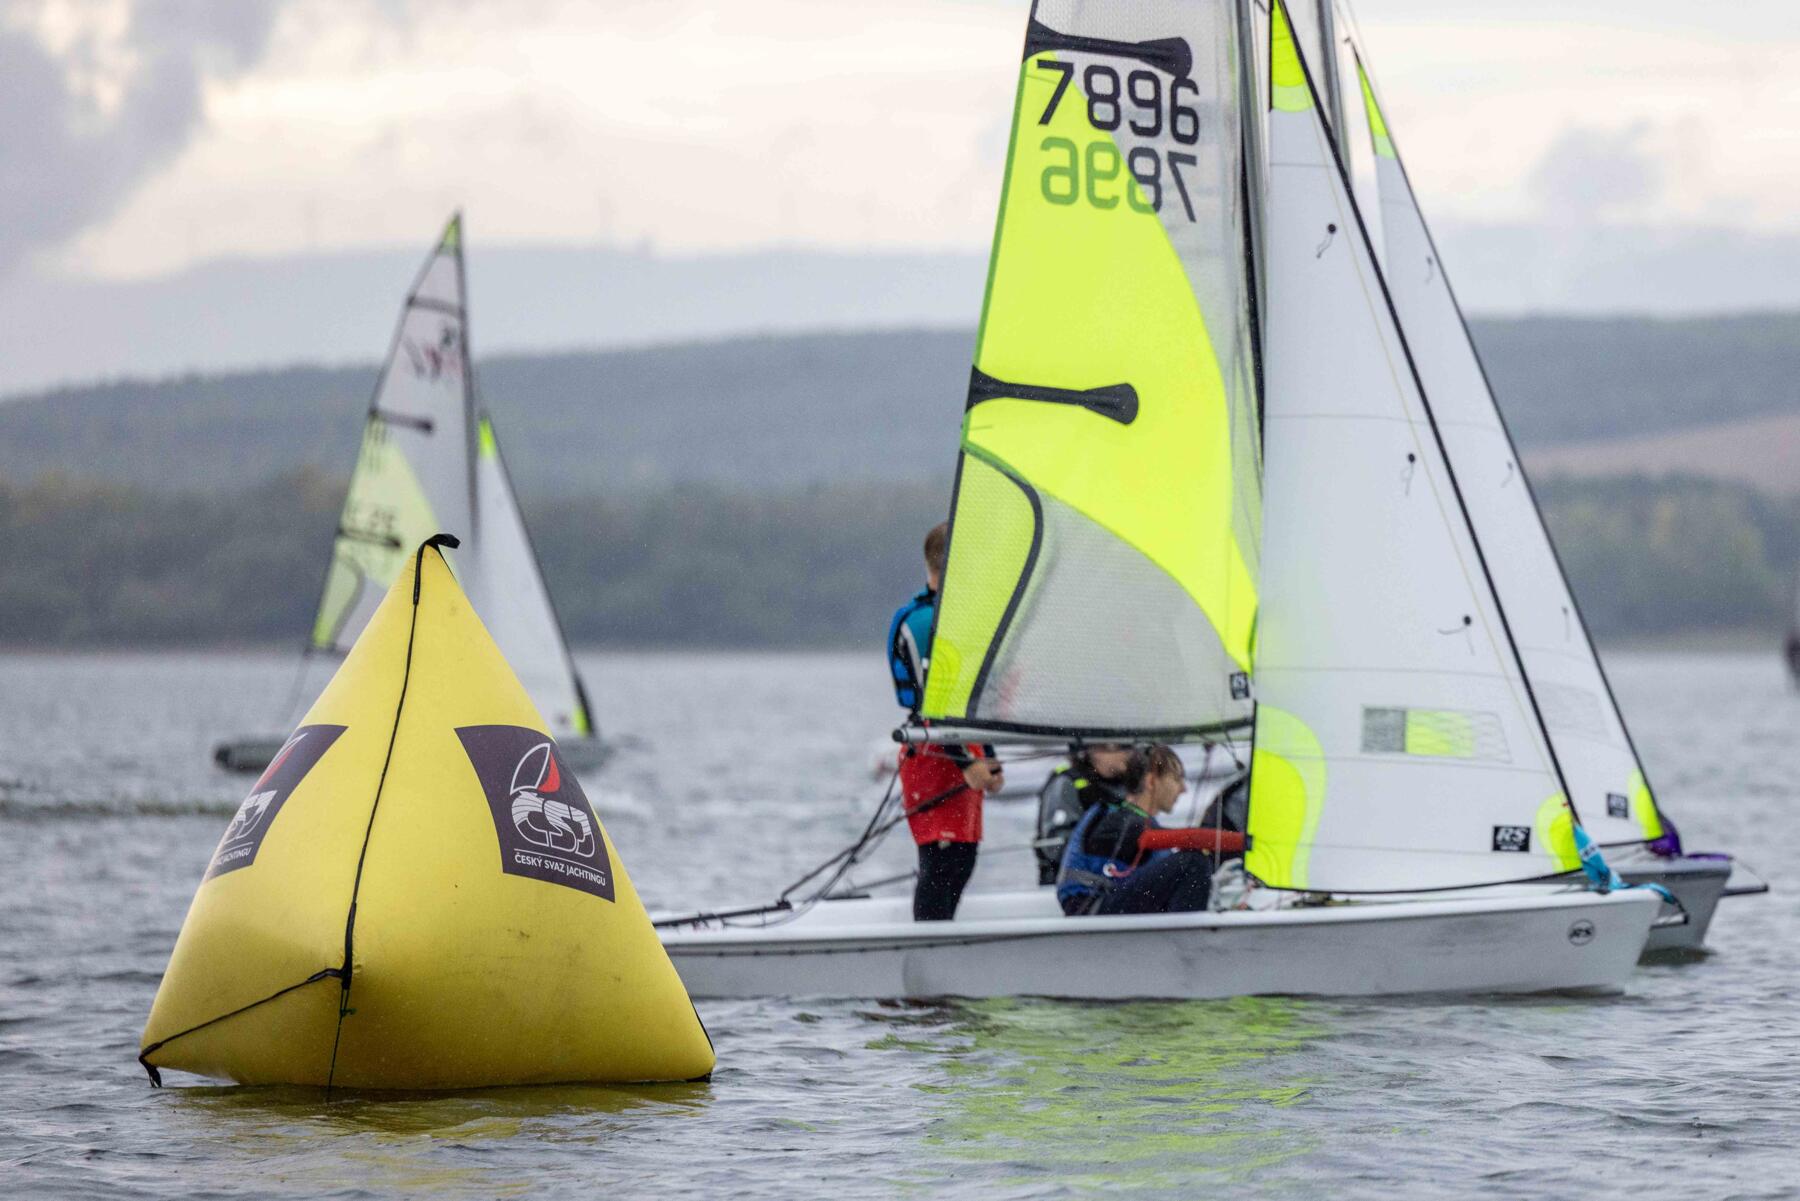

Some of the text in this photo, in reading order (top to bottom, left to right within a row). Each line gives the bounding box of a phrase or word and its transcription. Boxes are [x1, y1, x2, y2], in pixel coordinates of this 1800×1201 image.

[1037, 60, 1199, 145] 7896
[514, 852, 606, 886] ČESKÝ SVAZ JACHTINGU
